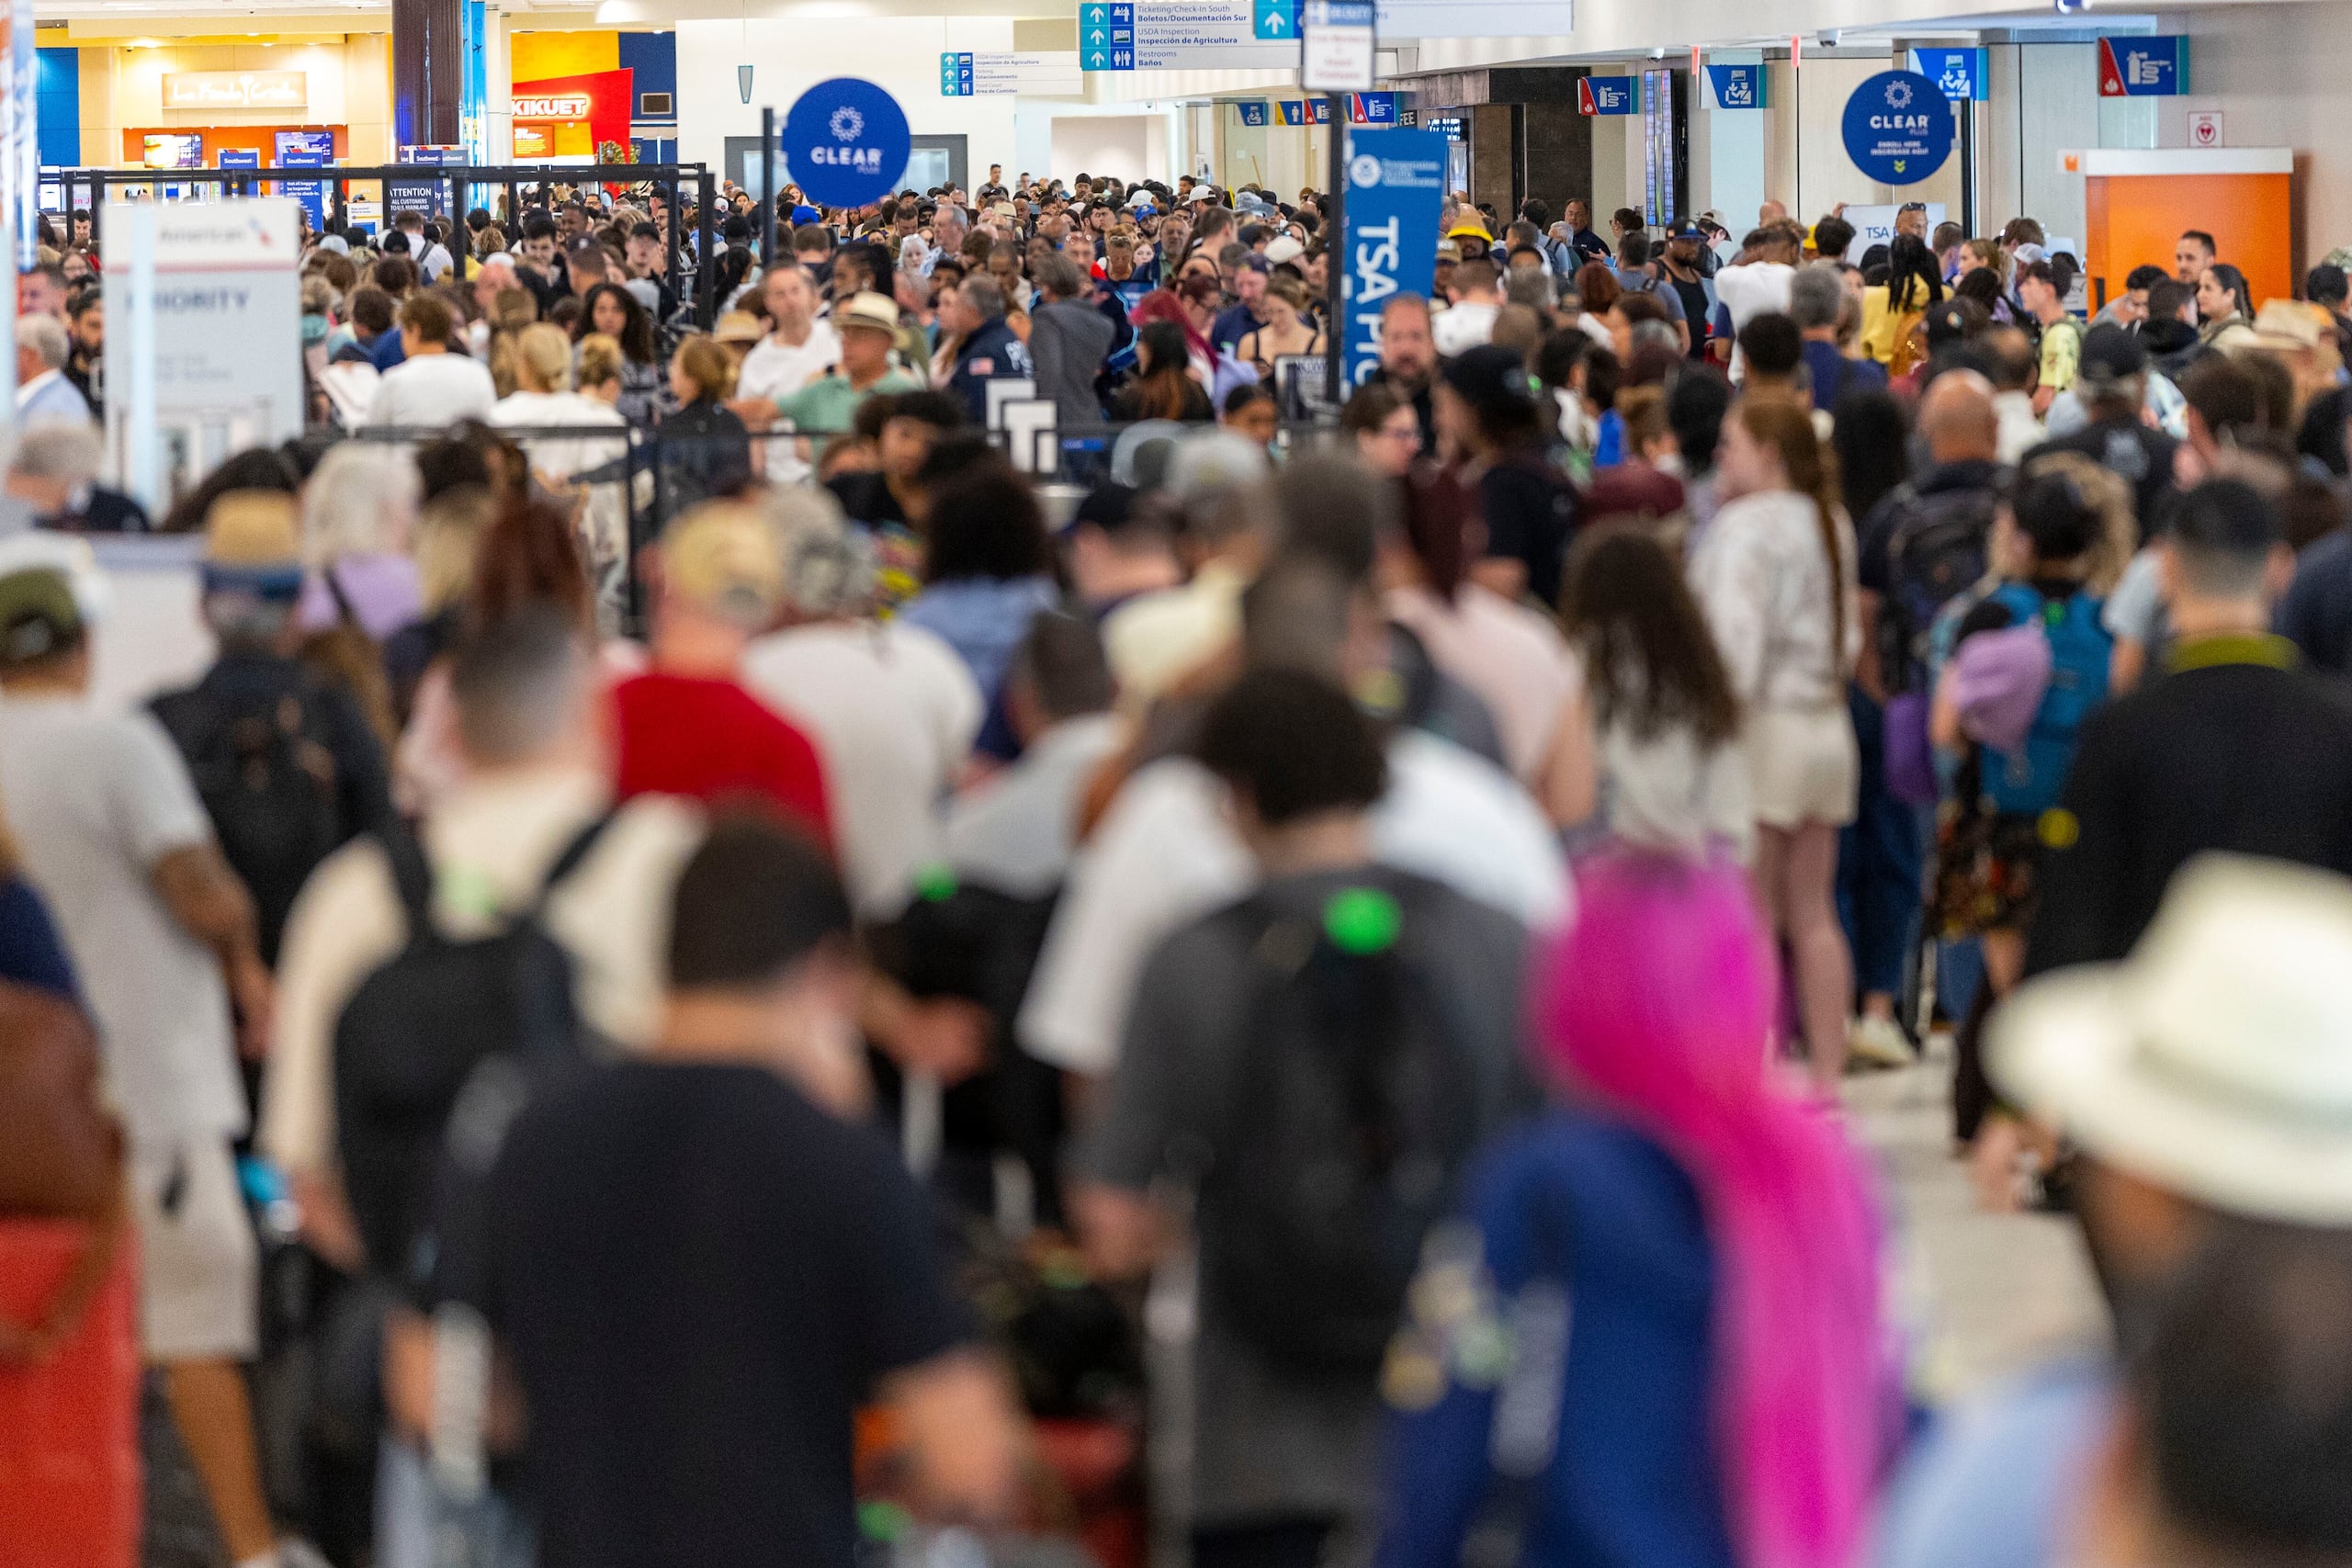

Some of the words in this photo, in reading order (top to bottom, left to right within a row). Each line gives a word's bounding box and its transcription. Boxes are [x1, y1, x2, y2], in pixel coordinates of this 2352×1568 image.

[1138, 6, 1207, 14] Ticketing/Check-In
[1138, 37, 1180, 45] Inspección
[1870, 115, 1928, 129] CLEAR
[810, 147, 882, 165] CLEAR
[1865, 227, 1889, 238] TSA
[1356, 215, 1399, 305] TSA
